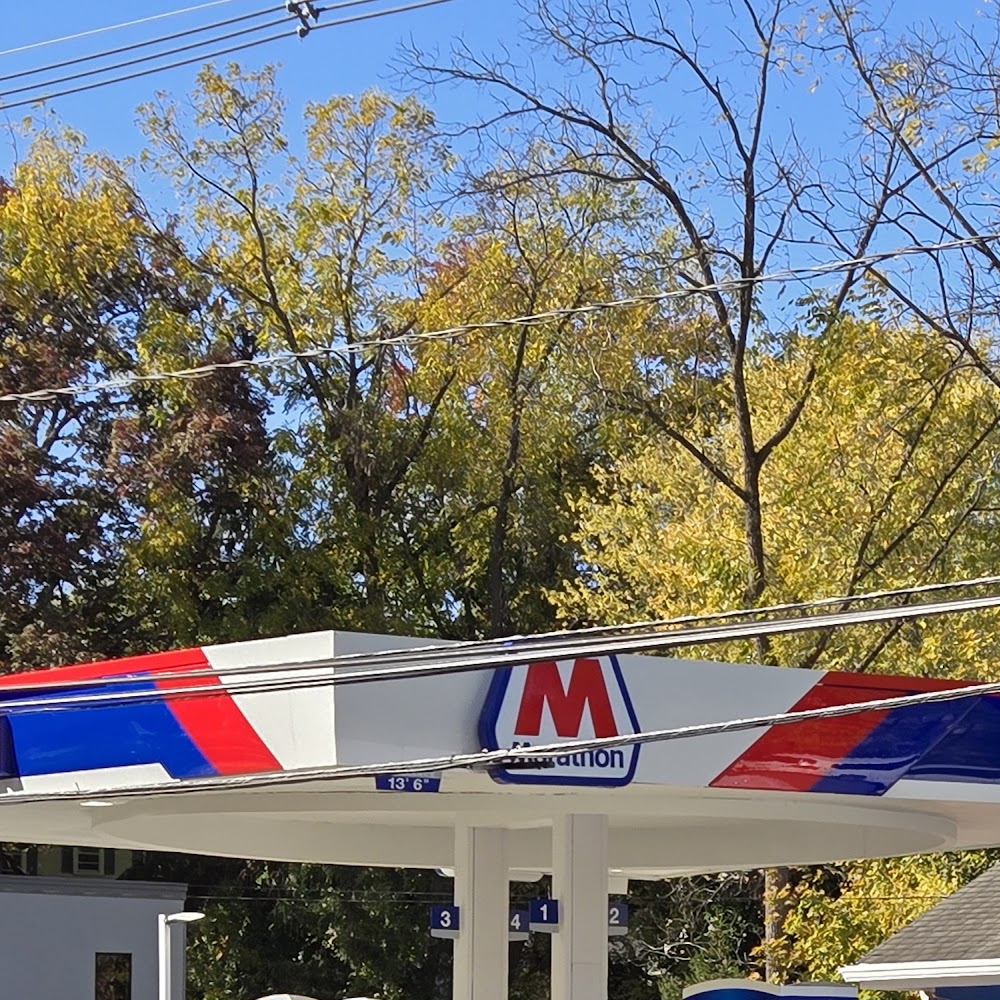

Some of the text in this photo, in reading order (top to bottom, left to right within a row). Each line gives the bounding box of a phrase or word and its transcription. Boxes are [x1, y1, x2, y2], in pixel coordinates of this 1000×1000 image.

[514, 658, 619, 738] M
[511, 741, 624, 769] athon
[440, 910, 451, 928] 3
[540, 903, 549, 921] 1
[609, 907, 620, 924] 2
[510, 913, 521, 930] 4
